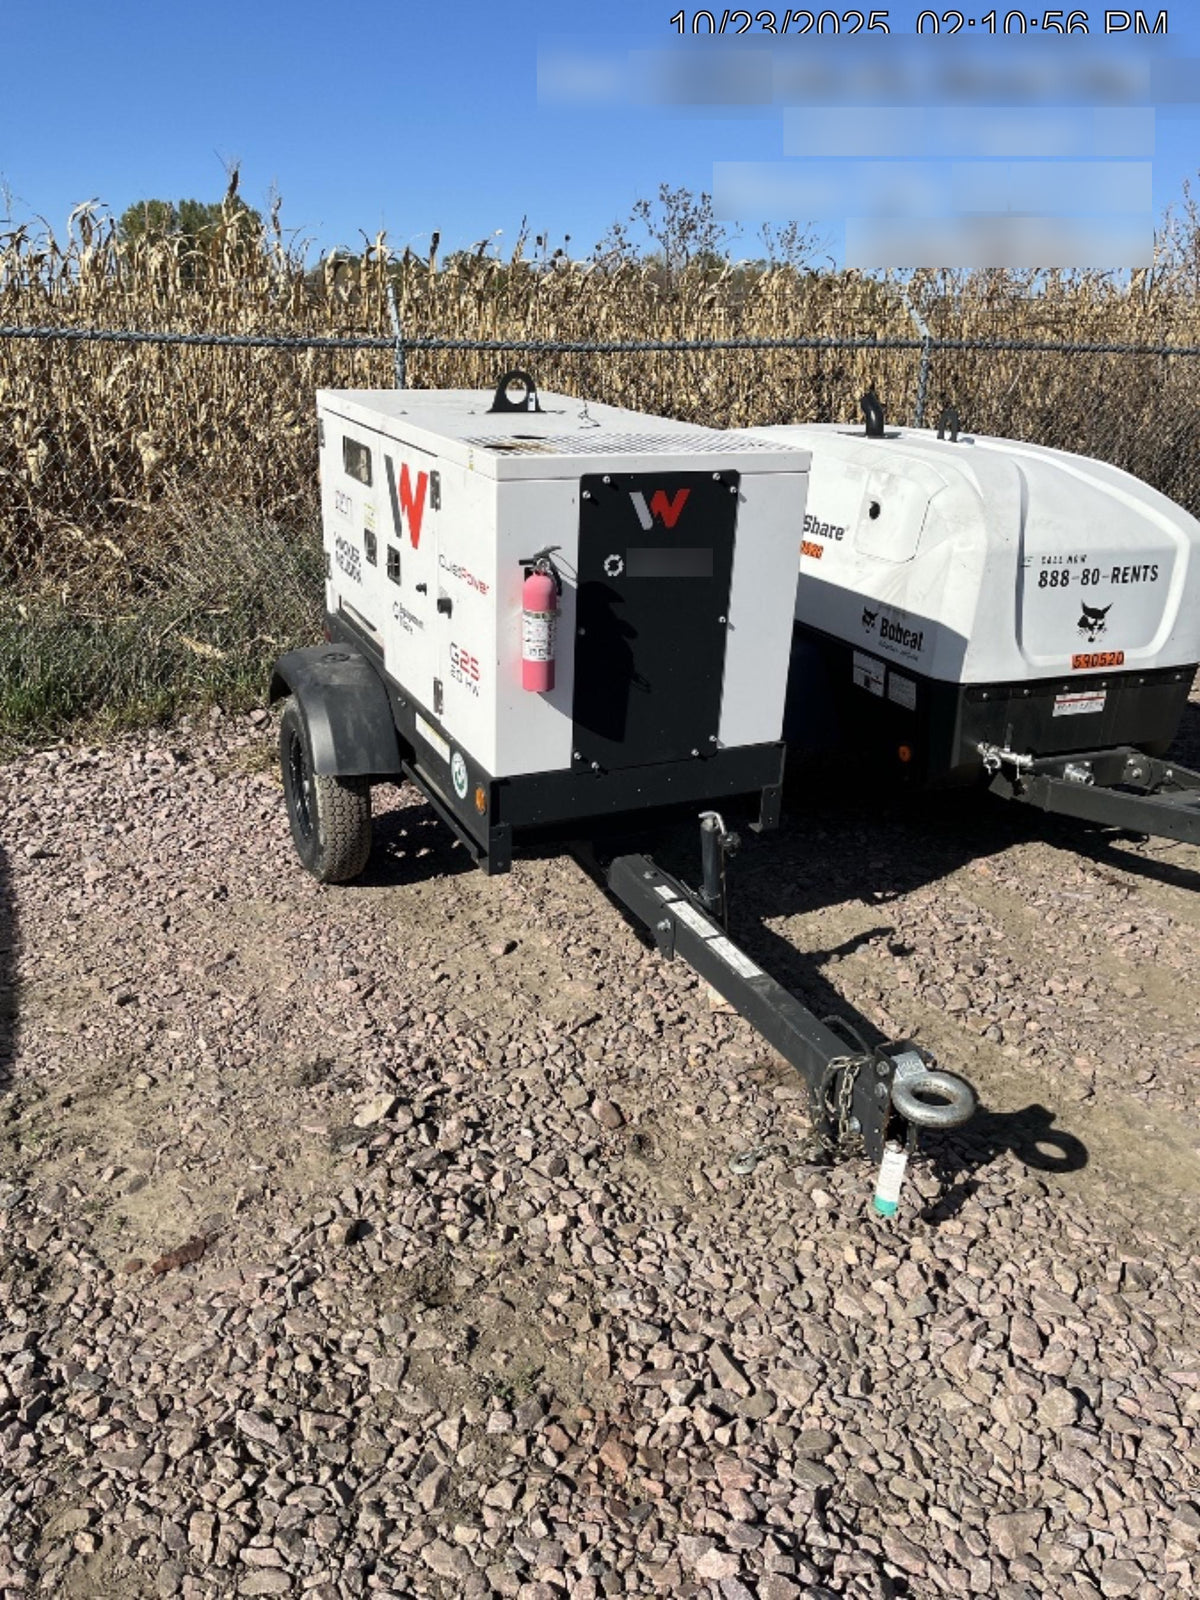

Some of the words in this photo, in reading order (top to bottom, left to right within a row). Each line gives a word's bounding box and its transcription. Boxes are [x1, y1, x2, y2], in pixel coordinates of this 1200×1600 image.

[803, 514, 845, 541] Share
[1038, 564, 1159, 588] 888-80-RENTS
[880, 616, 924, 652] Bobcat
[1072, 650, 1125, 670] 590520
